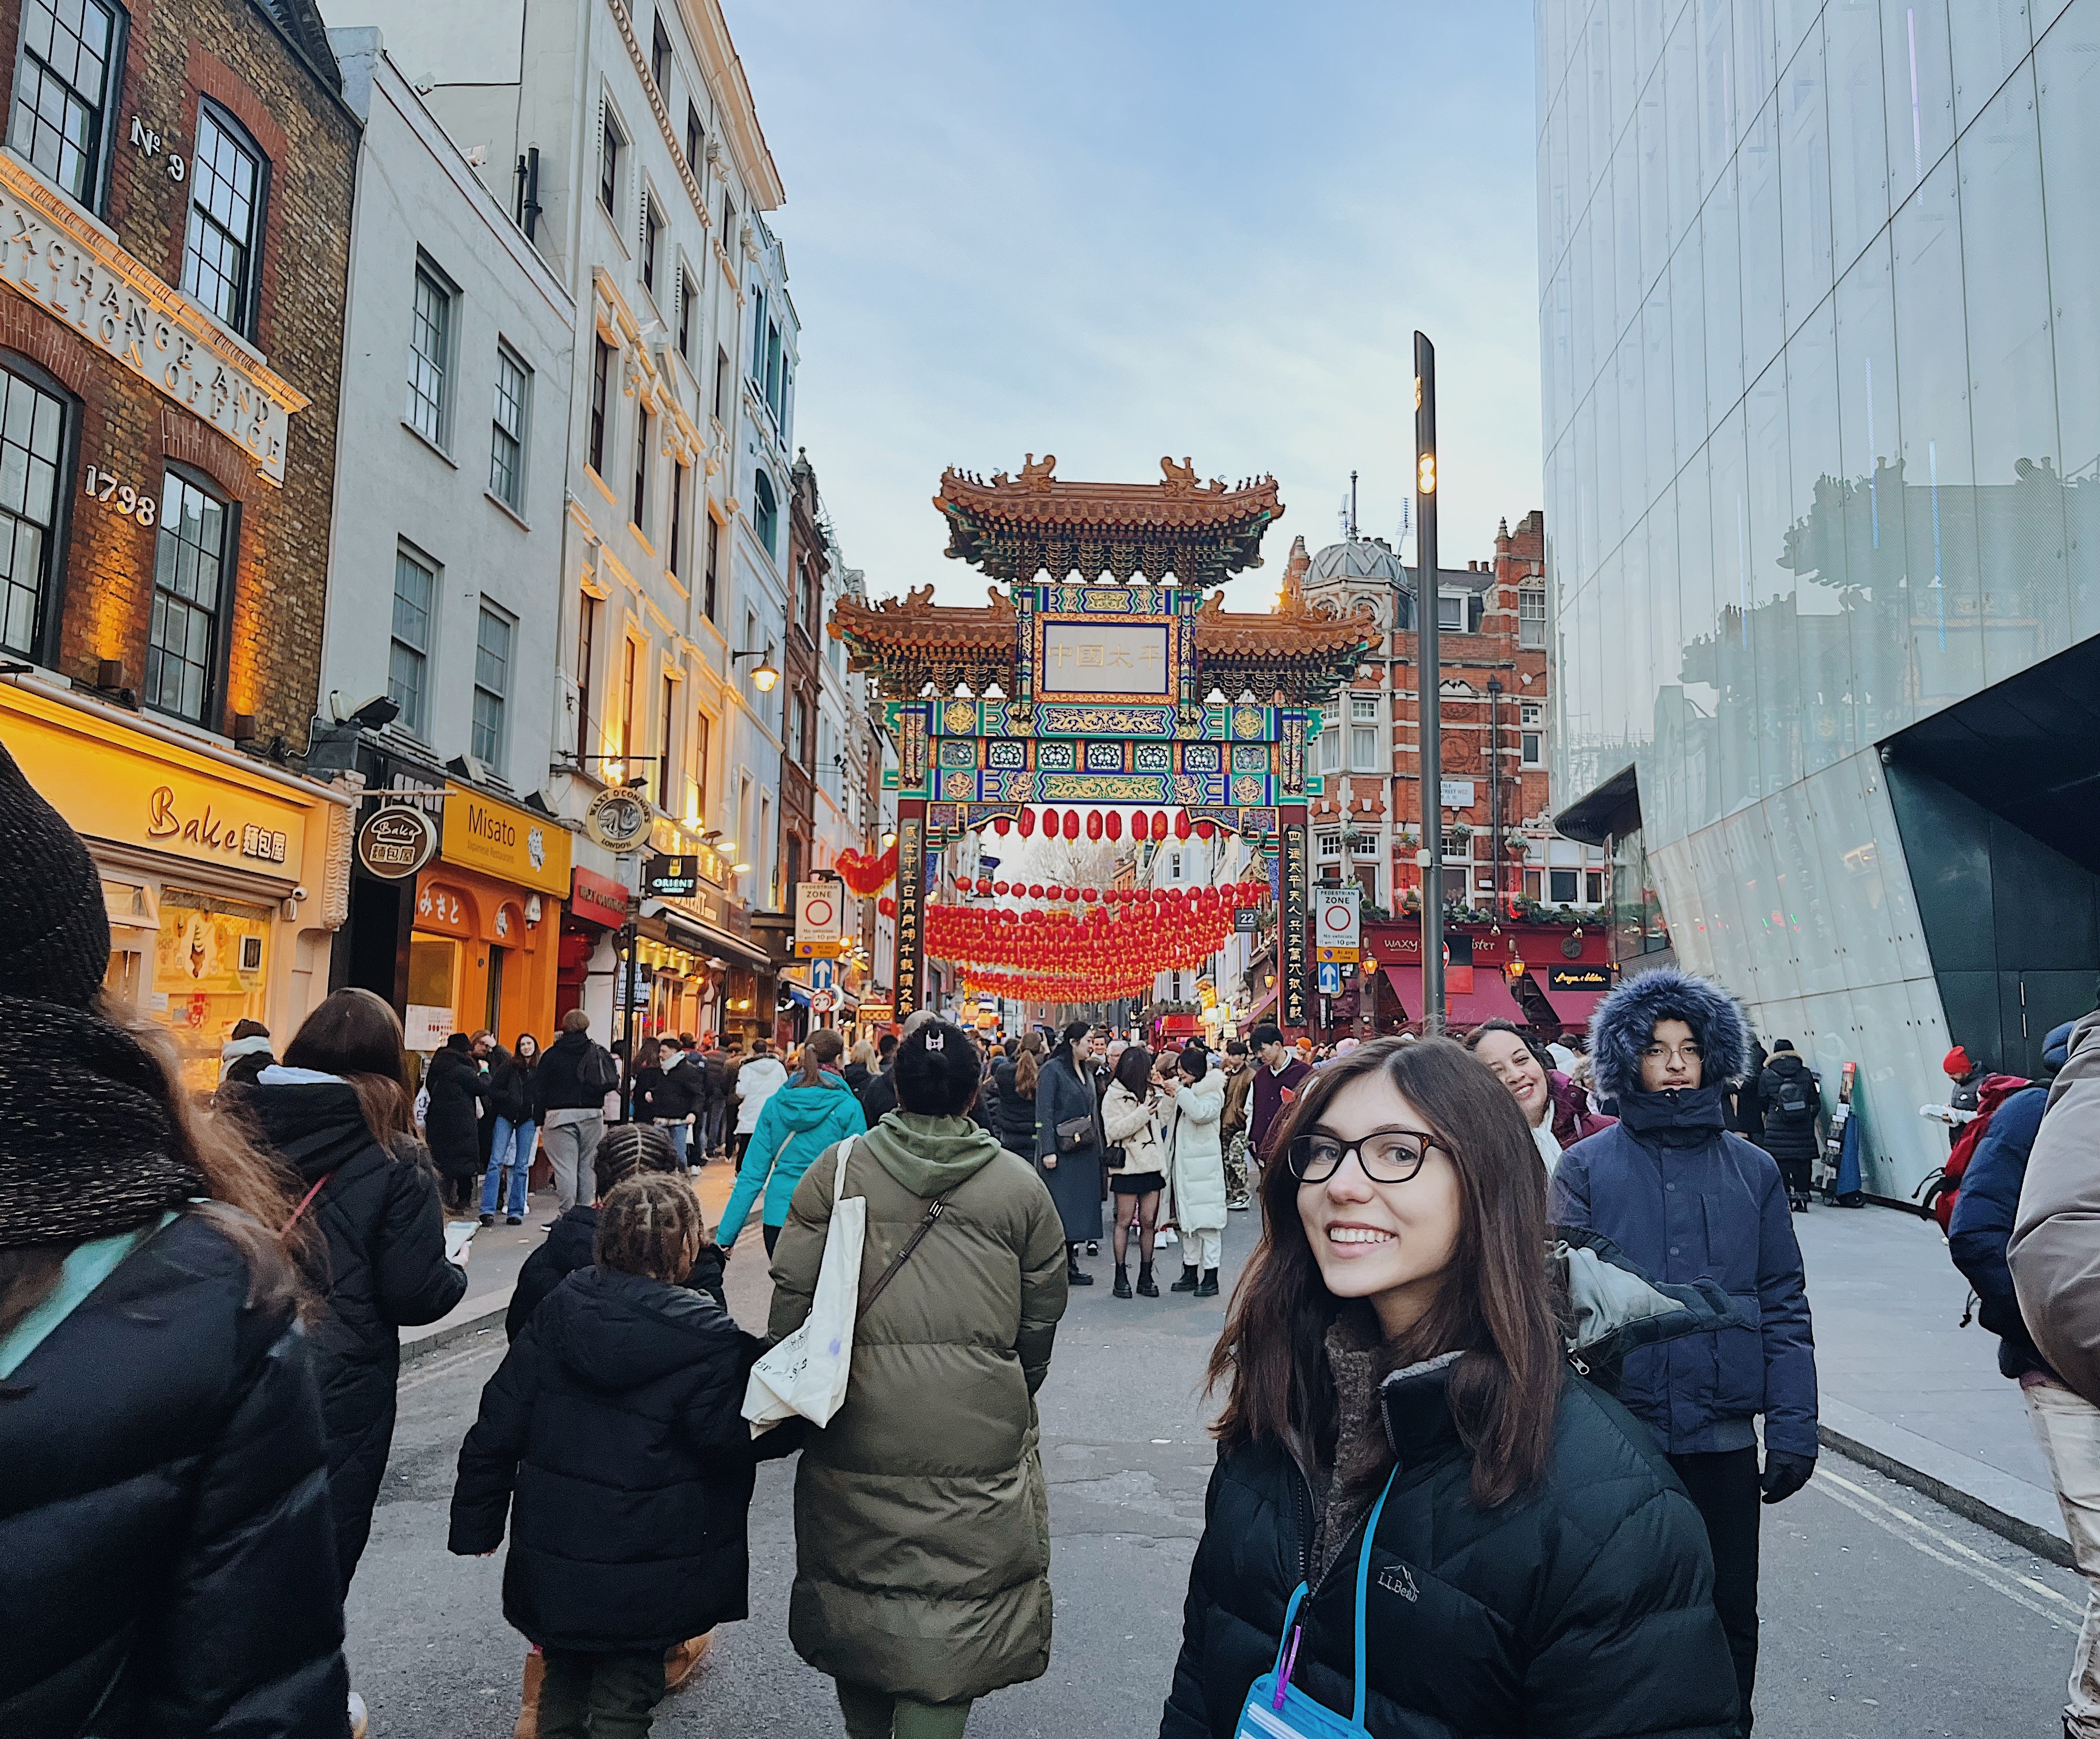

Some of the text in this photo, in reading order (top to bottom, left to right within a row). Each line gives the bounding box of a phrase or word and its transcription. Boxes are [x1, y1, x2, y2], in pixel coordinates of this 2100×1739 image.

[167, 154, 185, 181] 9
[0, 199, 269, 426] XCHANGE AND
[165, 362, 280, 465] OFFICE
[85, 465, 156, 526] 1798
[1047, 642, 1164, 670] 中國太平
[147, 786, 238, 848] Bake
[589, 792, 609, 816] WAXY
[379, 821, 414, 836] Bake
[469, 804, 515, 846] Misato
[467, 839, 489, 856] Japanese
[601, 838, 632, 849] LONDON
[652, 878, 694, 888] ORIENT
[420, 889, 459, 924] みさと
[1241, 913, 1254, 924] 22
[1471, 938, 1495, 951] ister
